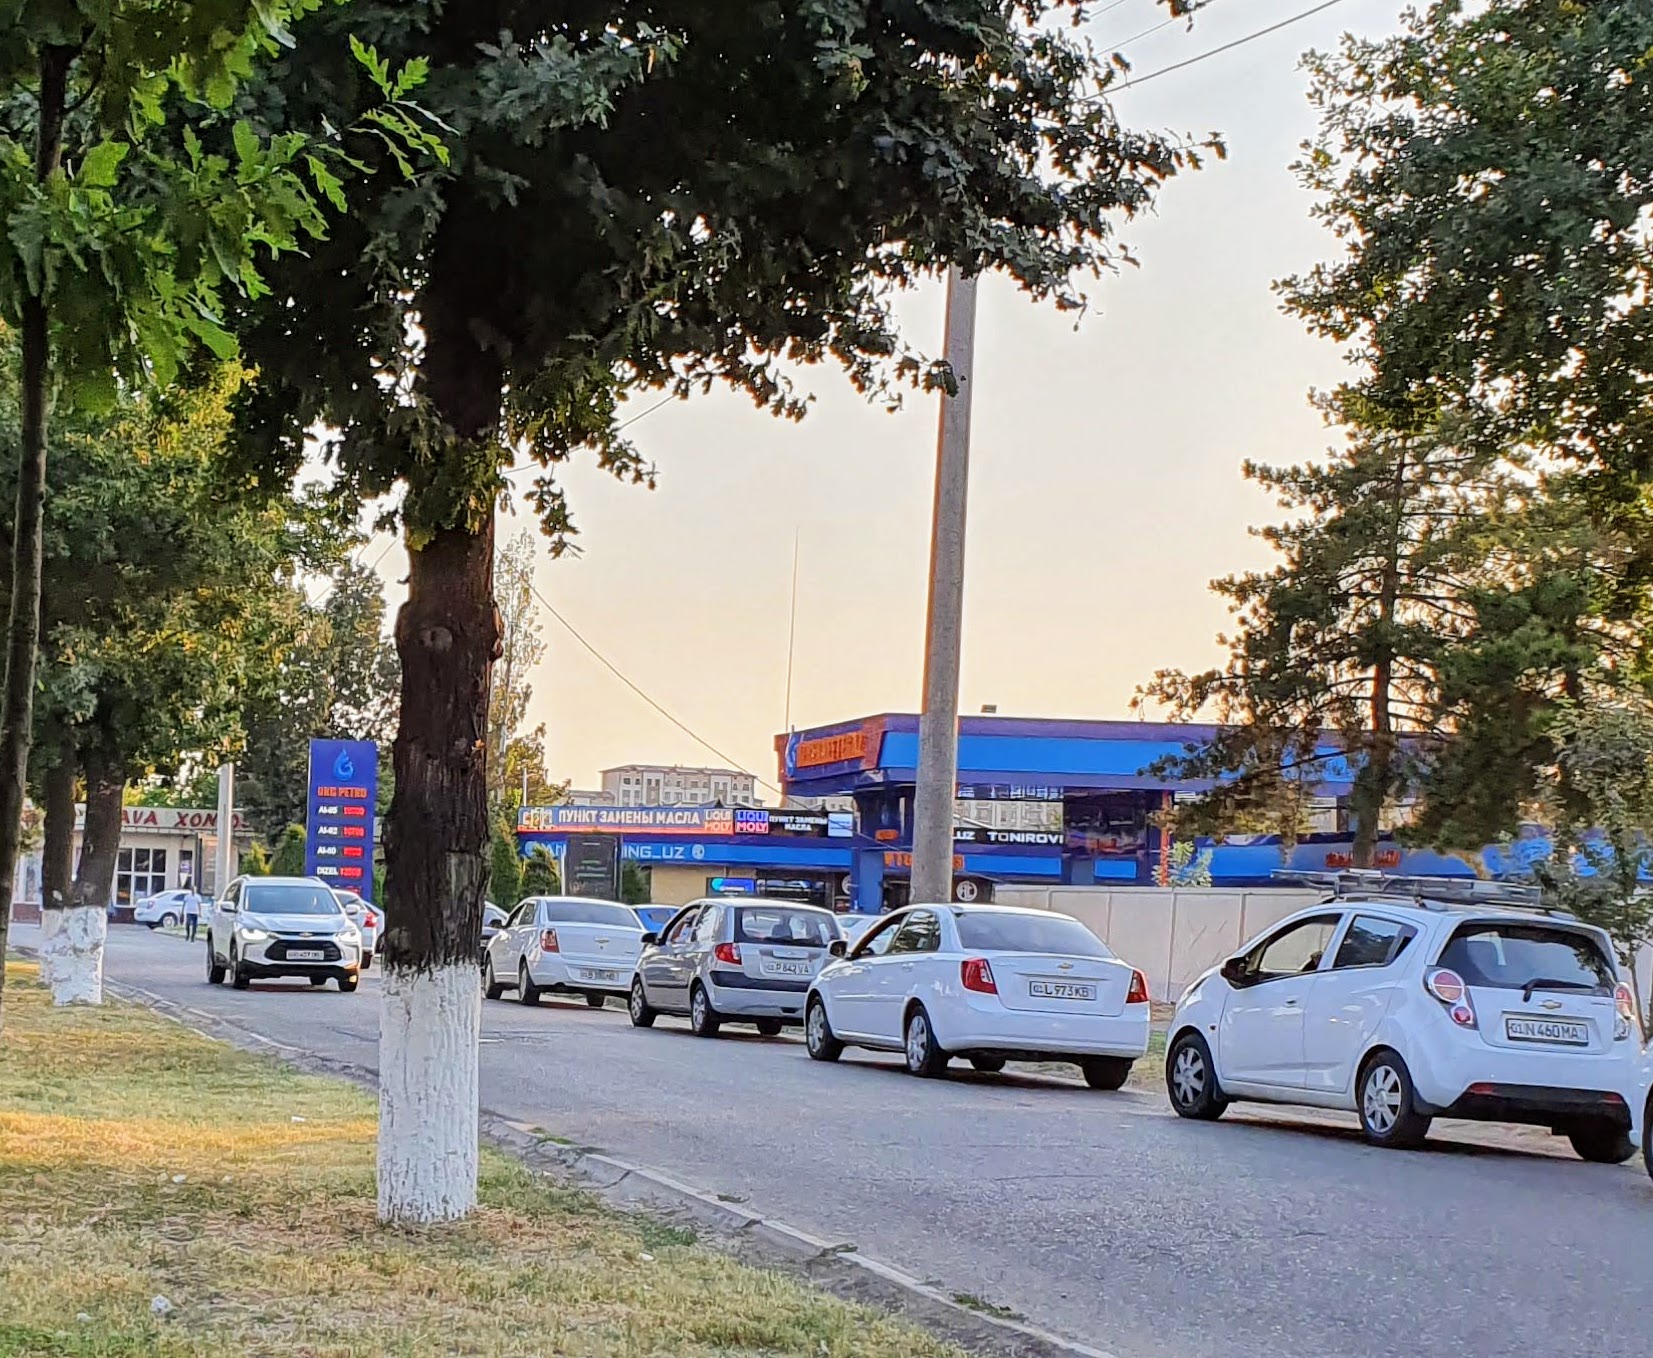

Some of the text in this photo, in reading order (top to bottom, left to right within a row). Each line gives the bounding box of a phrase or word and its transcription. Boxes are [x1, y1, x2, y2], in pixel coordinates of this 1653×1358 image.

[558, 809, 700, 825] ПУНКТ ЗАМЕНЫ МАСЛА
[705, 809, 731, 821] LIQUI
[736, 810, 769, 822] LIQUI
[704, 821, 731, 831] MOLY
[736, 822, 769, 832] MOLY
[784, 823, 812, 831] МАСЛА
